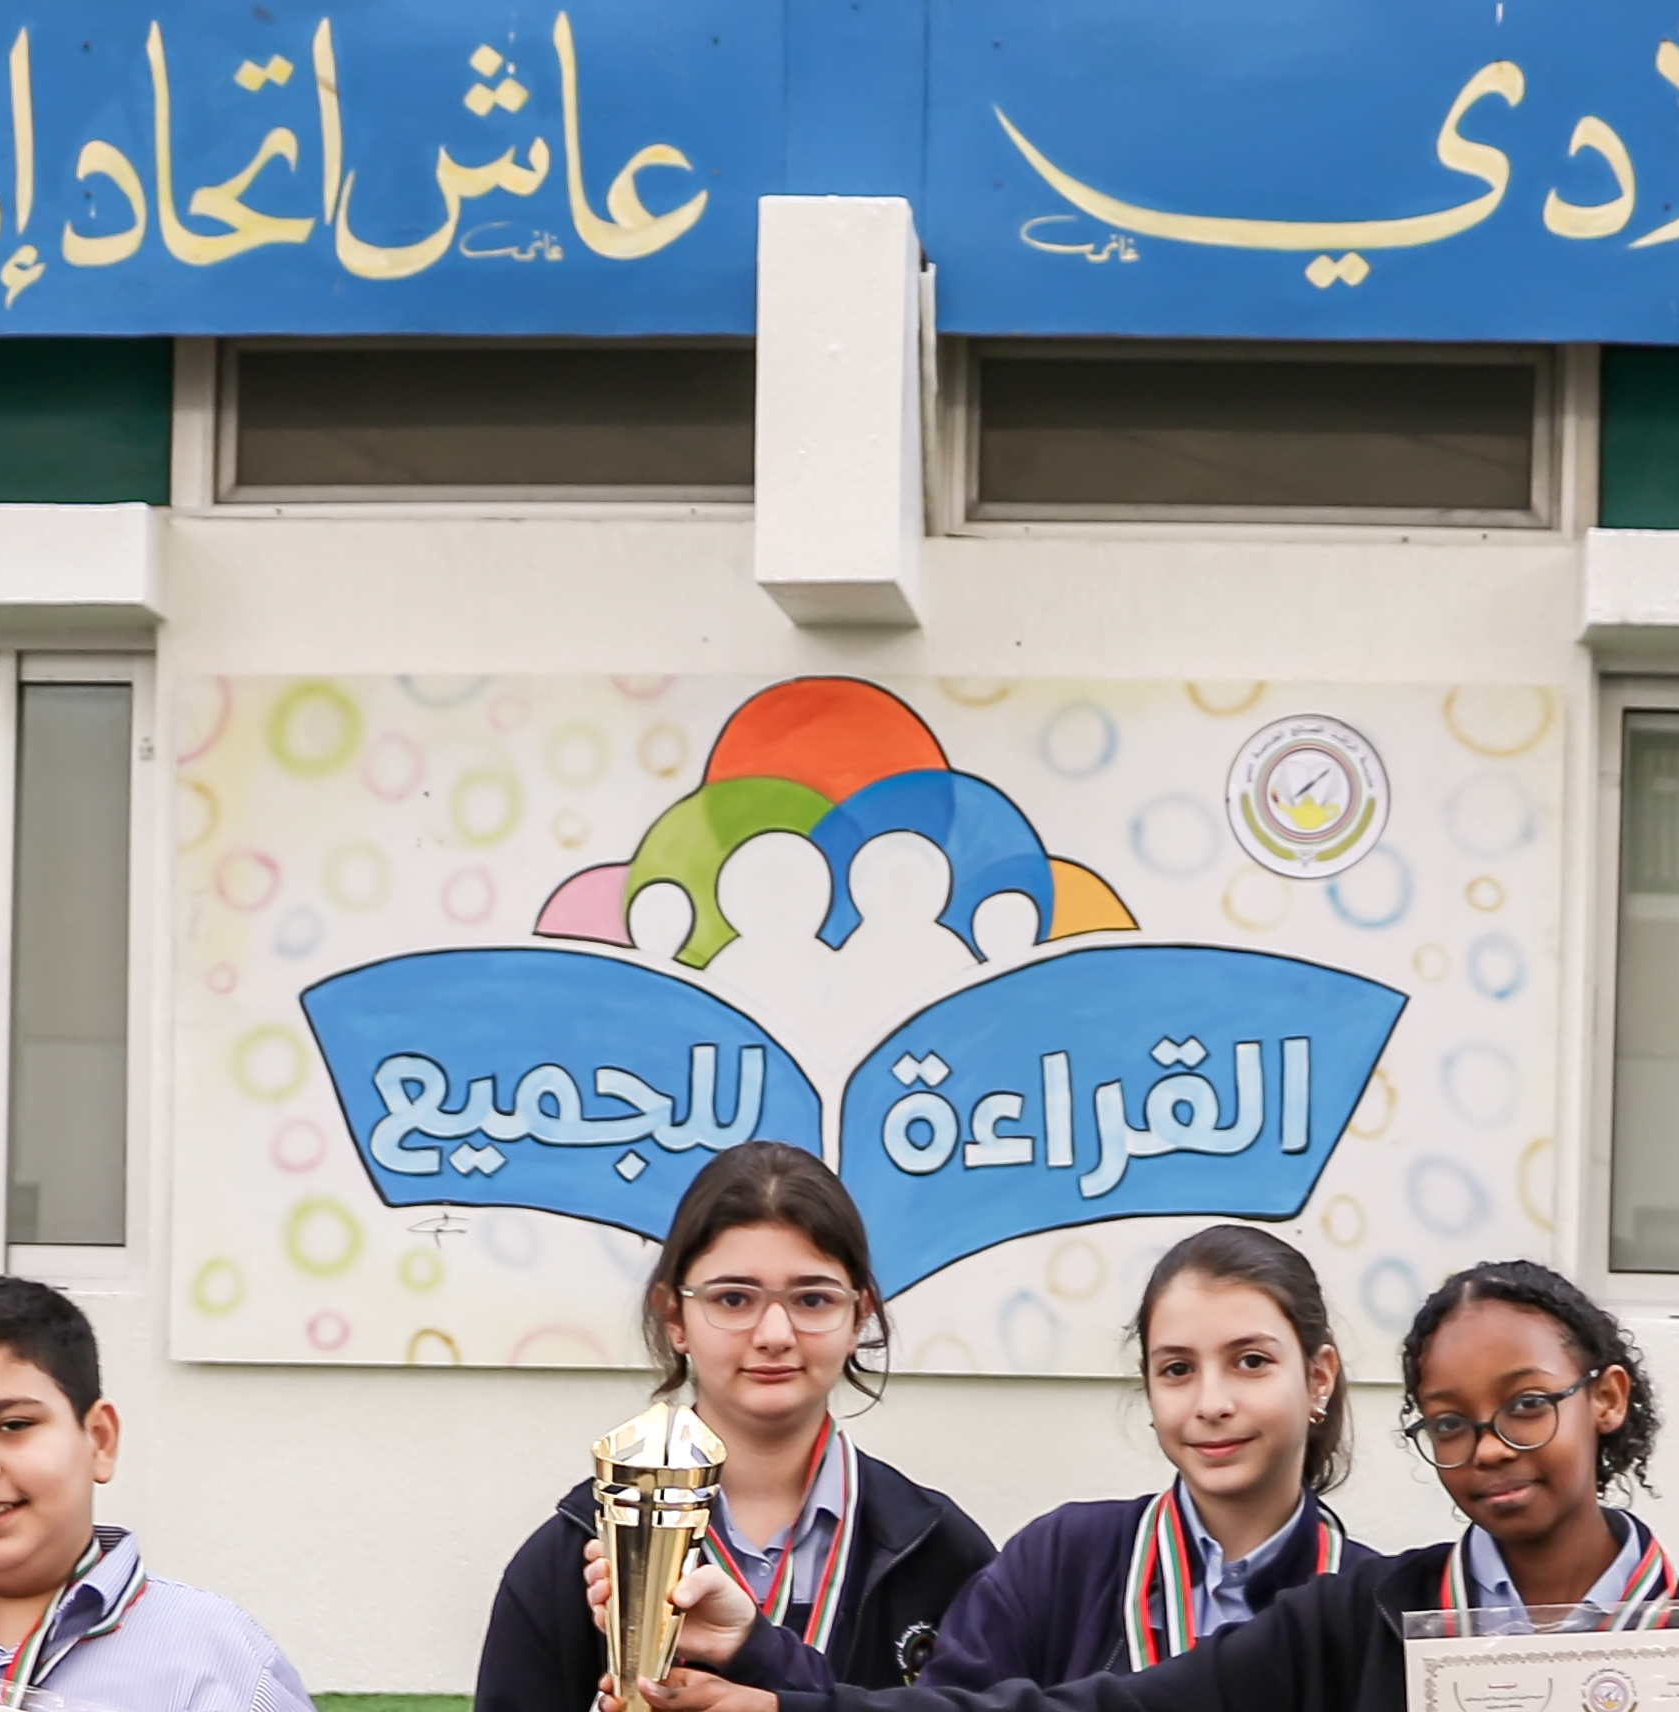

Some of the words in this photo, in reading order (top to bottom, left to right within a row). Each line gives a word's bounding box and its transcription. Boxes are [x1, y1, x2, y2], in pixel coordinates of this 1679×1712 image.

[63, 20, 342, 266] اتحاد
[335, 13, 709, 279] عاش
[369, 1044, 768, 1182] للجميع
[881, 1036, 1311, 1198] القراءة
